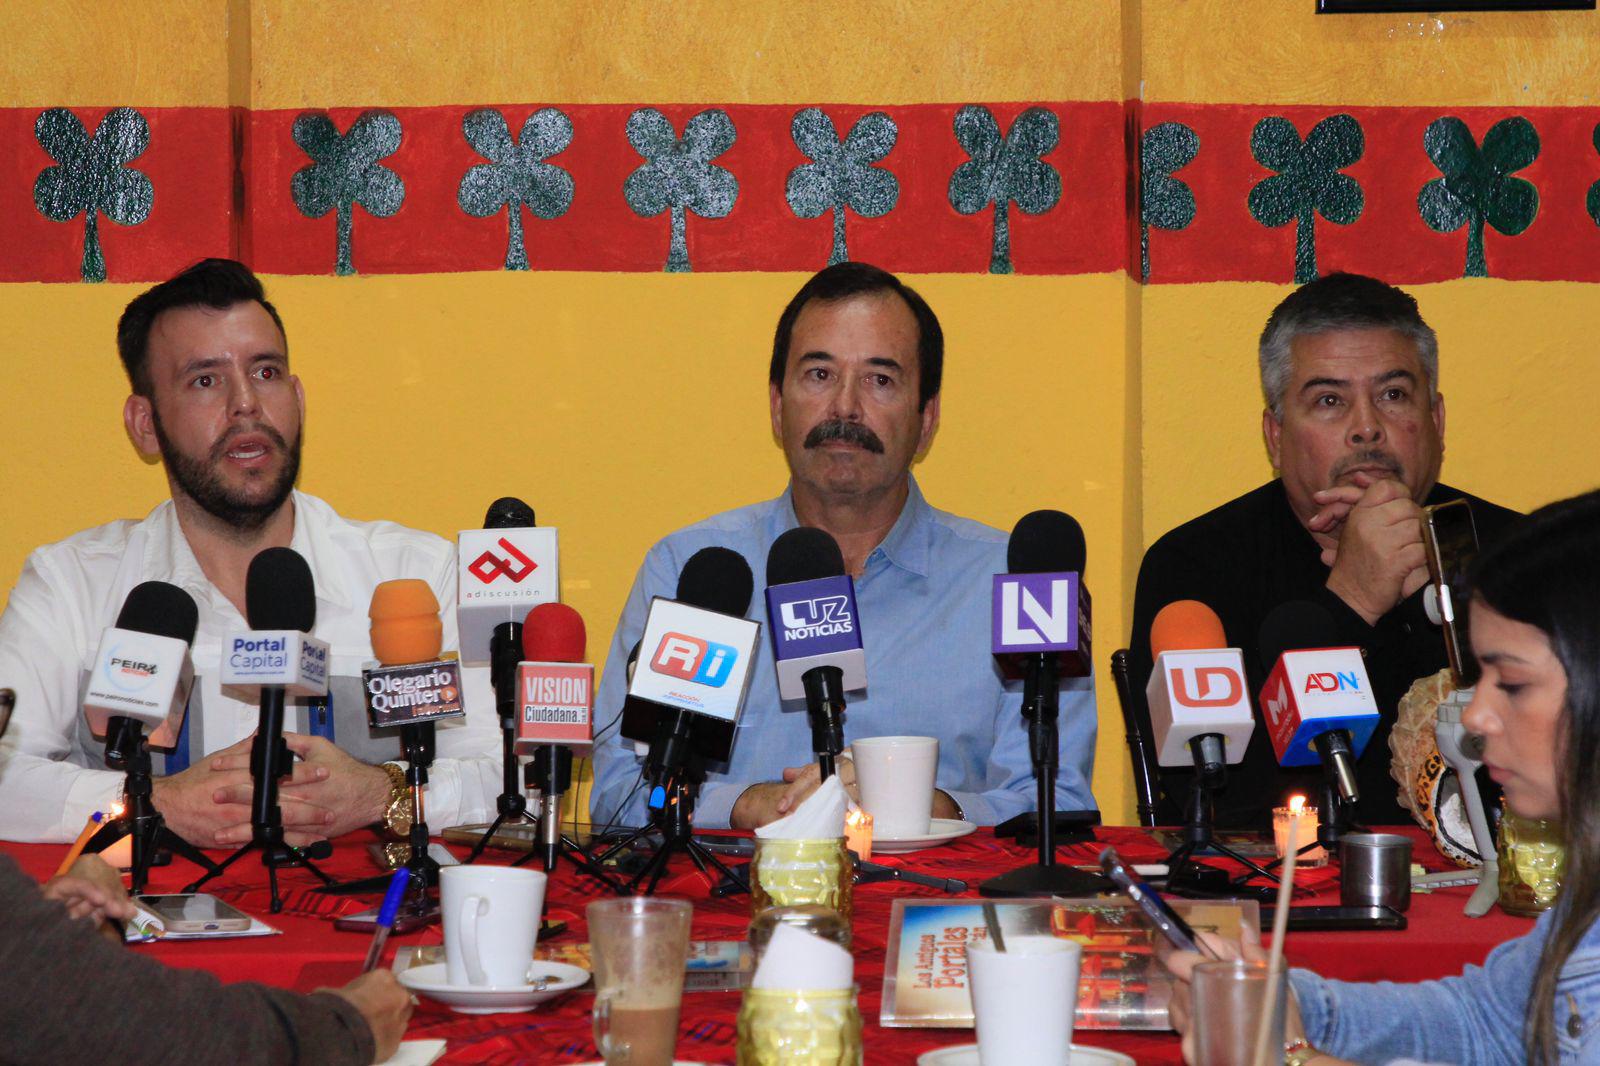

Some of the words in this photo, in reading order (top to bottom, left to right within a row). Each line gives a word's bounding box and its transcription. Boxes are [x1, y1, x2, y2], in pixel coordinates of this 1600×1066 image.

[783, 621, 853, 641] NOTICIAS
[233, 636, 286, 652] Portal
[302, 640, 327, 662] Portal
[229, 652, 288, 669] Capital
[368, 667, 452, 695] Olegario
[525, 676, 588, 704] VISION
[1304, 671, 1360, 694] ADN
[933, 926, 969, 989] Portales
